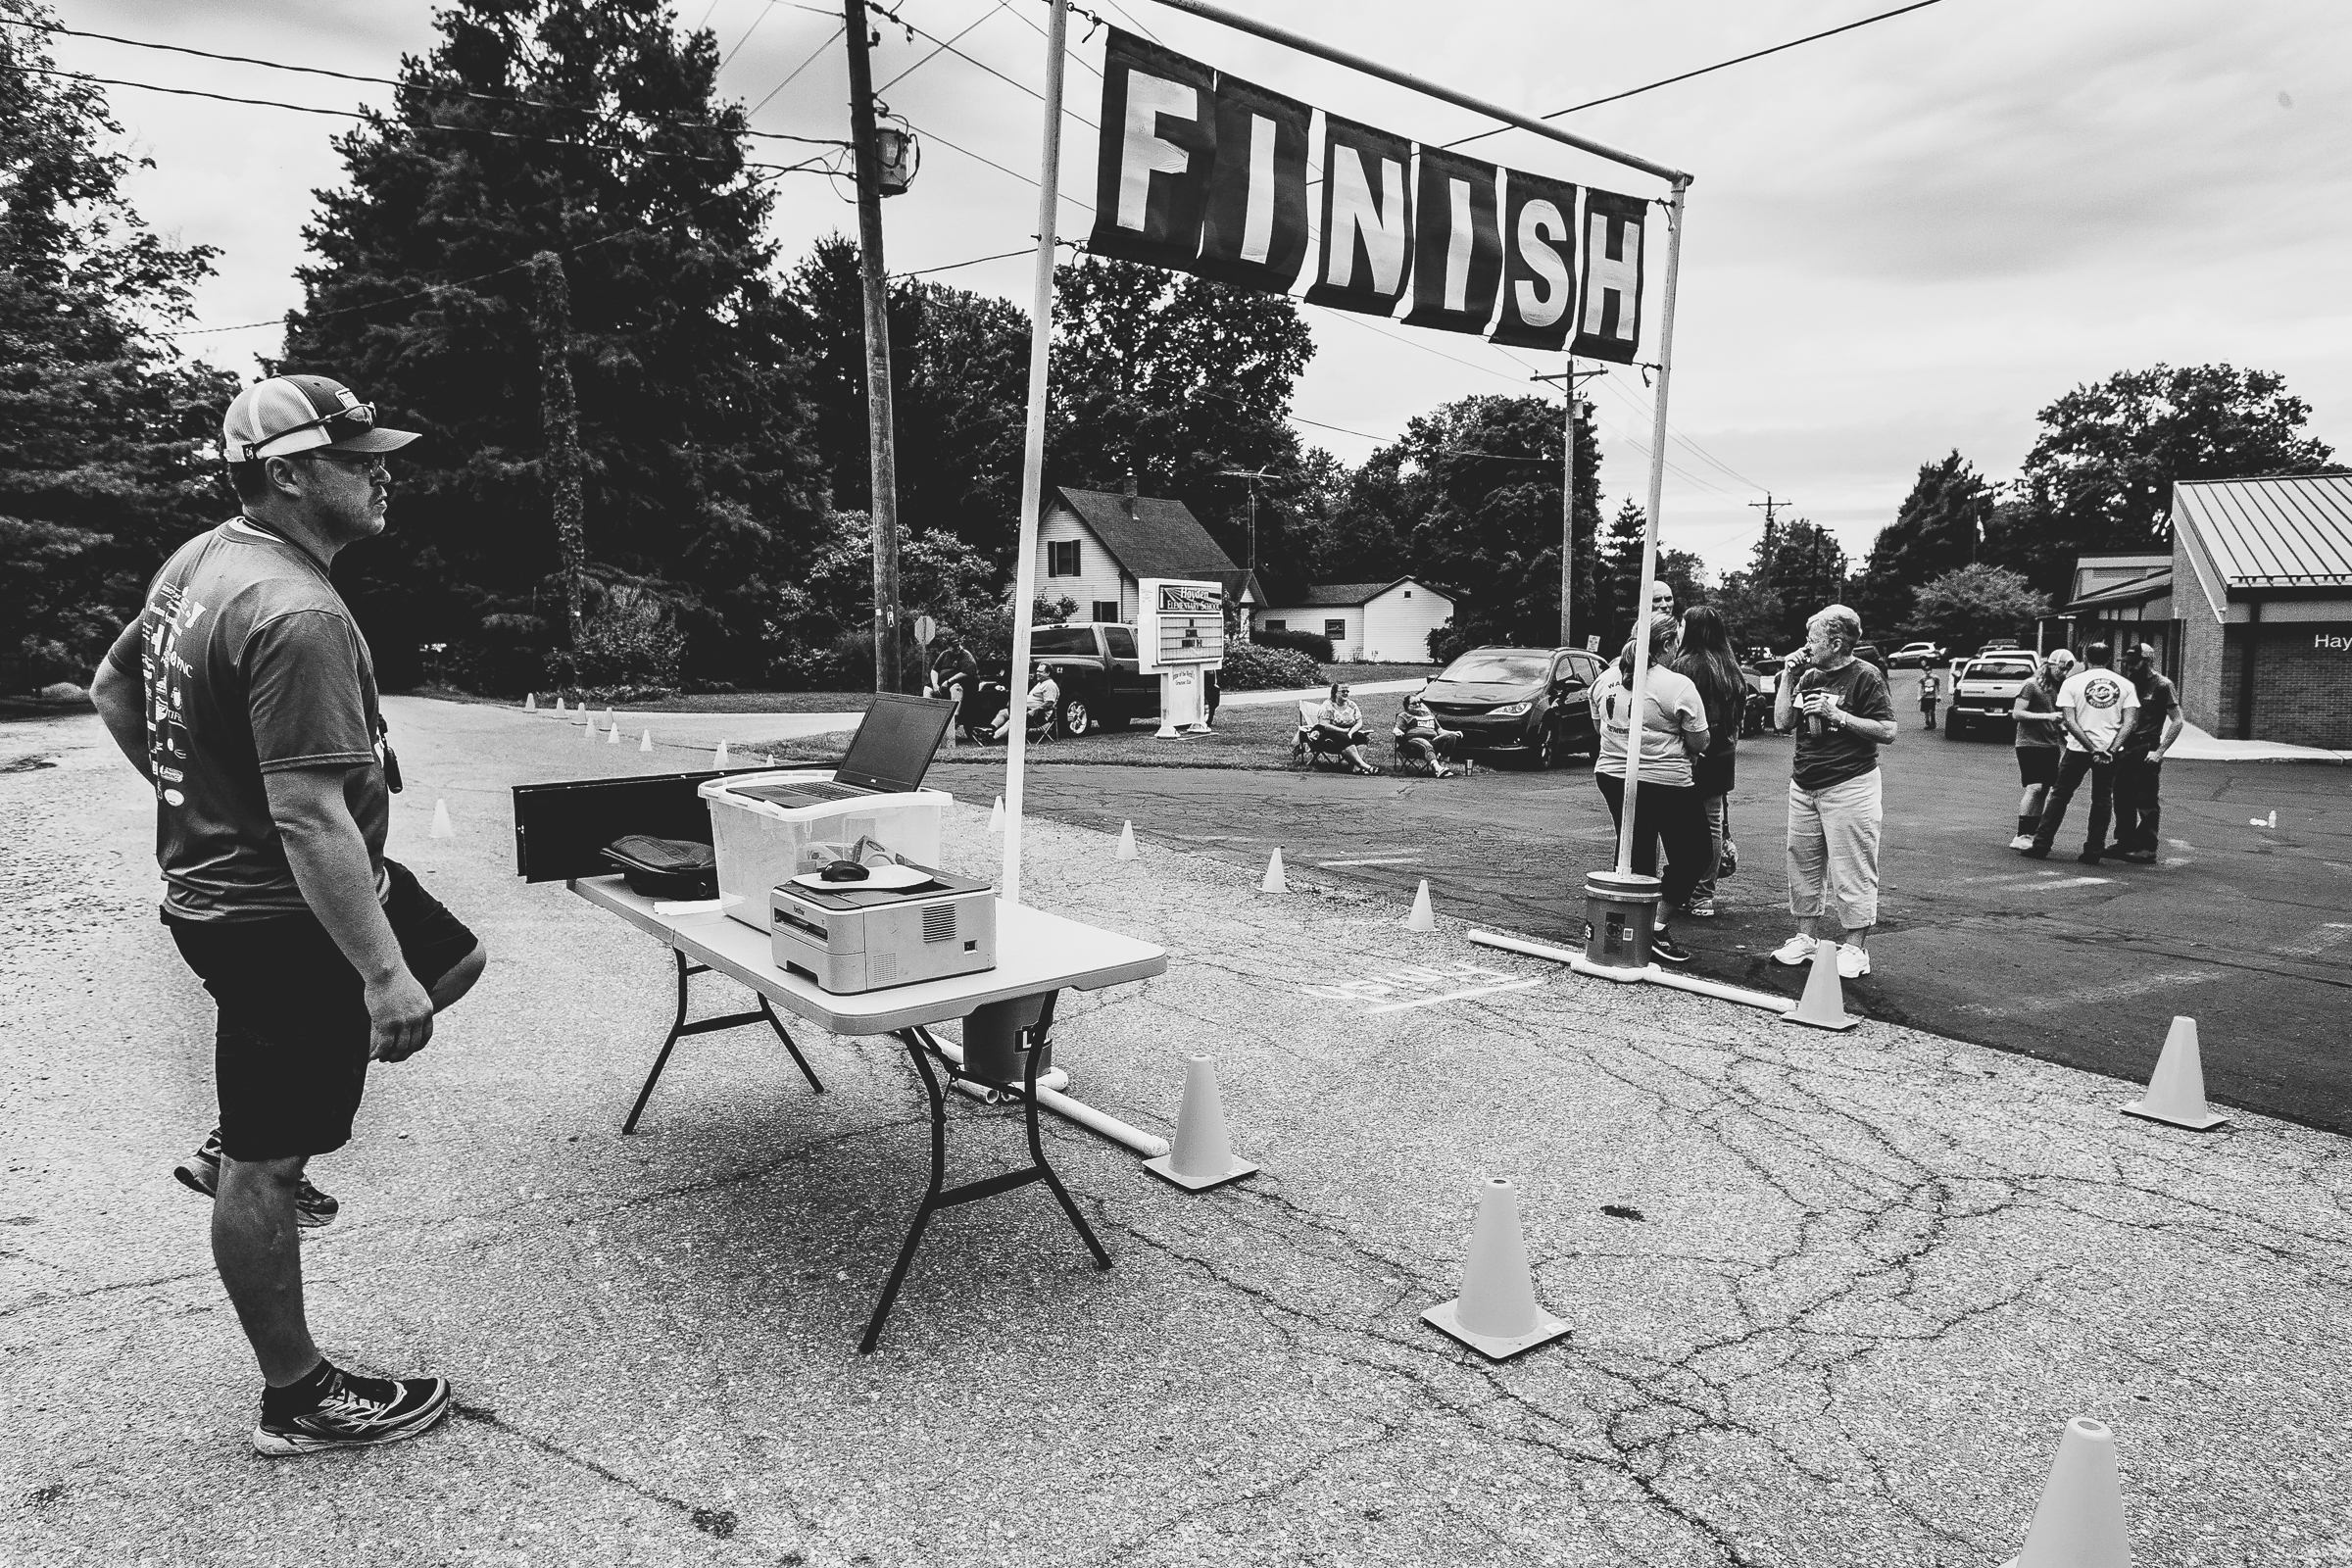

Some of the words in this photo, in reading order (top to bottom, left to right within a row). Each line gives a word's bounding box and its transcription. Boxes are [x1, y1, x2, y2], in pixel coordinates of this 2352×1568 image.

[1116, 68, 1641, 341] FINISH
[1181, 587, 1209, 602] Hayden
[2315, 634, 2352, 652] Hay
[176, 656, 193, 679] PNC
